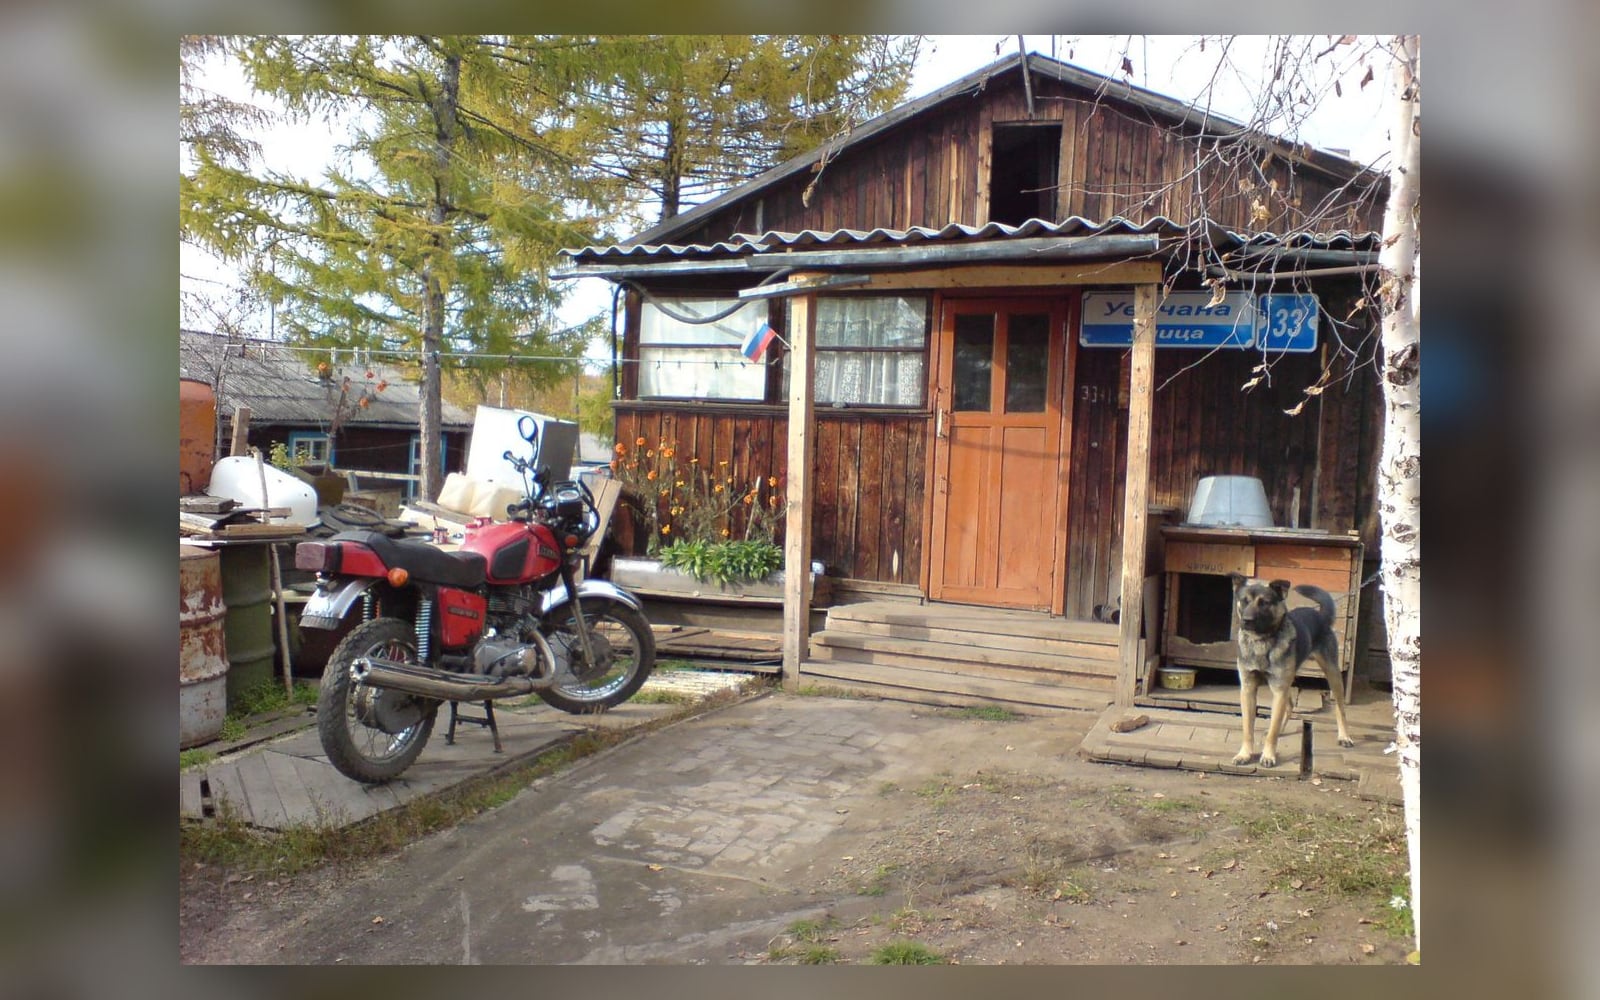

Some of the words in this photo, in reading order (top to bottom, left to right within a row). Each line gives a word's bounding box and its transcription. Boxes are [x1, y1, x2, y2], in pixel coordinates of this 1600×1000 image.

[1103, 301, 1231, 316] Уечана
[1272, 308, 1303, 337] 33
[1128, 328, 1204, 342] ица
